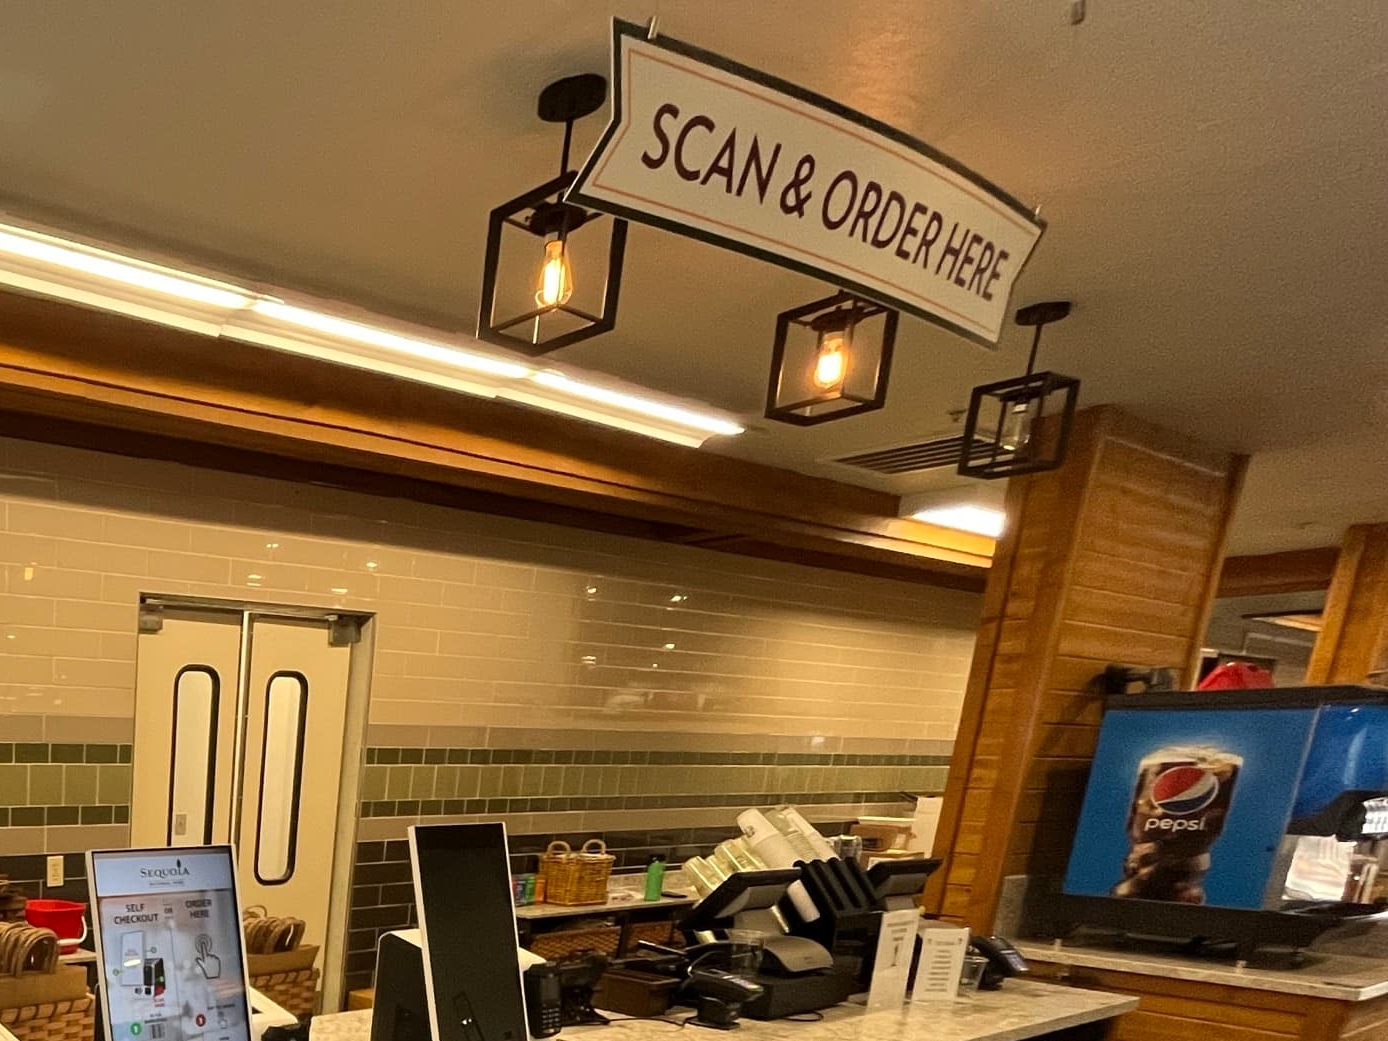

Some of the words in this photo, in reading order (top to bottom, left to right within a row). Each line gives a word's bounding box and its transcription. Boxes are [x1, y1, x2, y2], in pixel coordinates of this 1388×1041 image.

[640, 102, 783, 204] SCAN
[779, 152, 817, 219] &
[822, 169, 942, 270] ORDER
[936, 221, 1010, 301] HERE
[1144, 816, 1206, 832] pepsi
[140, 867, 190, 879] SEQUOIA
[125, 904, 145, 912] SELF
[184, 898, 212, 908] ORDER
[114, 914, 158, 924] CHECKOUT
[190, 909, 210, 919] HERE
